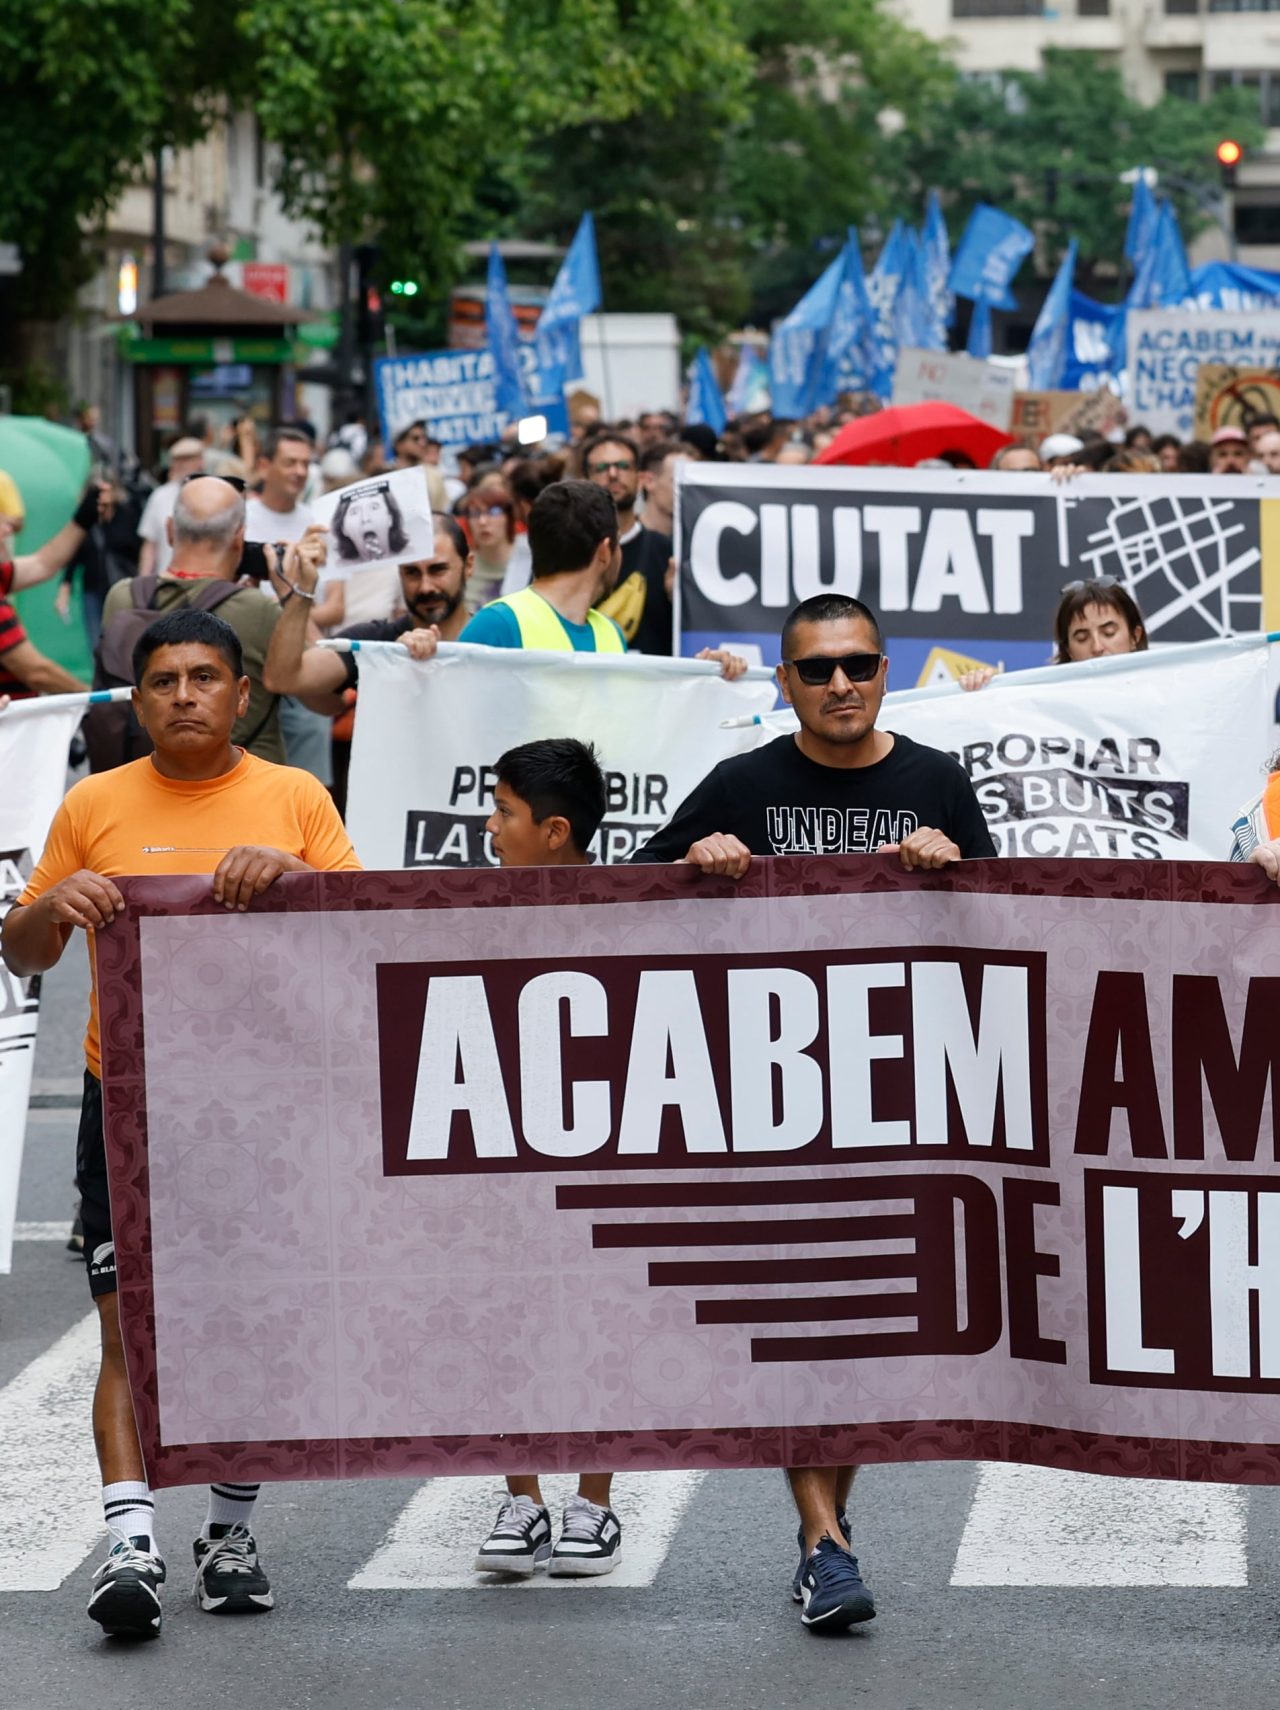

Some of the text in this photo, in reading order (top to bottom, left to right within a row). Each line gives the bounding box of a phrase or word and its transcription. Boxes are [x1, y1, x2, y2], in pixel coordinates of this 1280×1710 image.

[1137, 329, 1254, 352] ACABEM
[689, 500, 1035, 614] CIUTAT
[766, 806, 919, 854] UNDEAD
[1022, 776, 1176, 832] BUITS
[413, 819, 470, 863] LA
[405, 961, 1034, 1160] ACABEM
[913, 1172, 1068, 1365] DE
